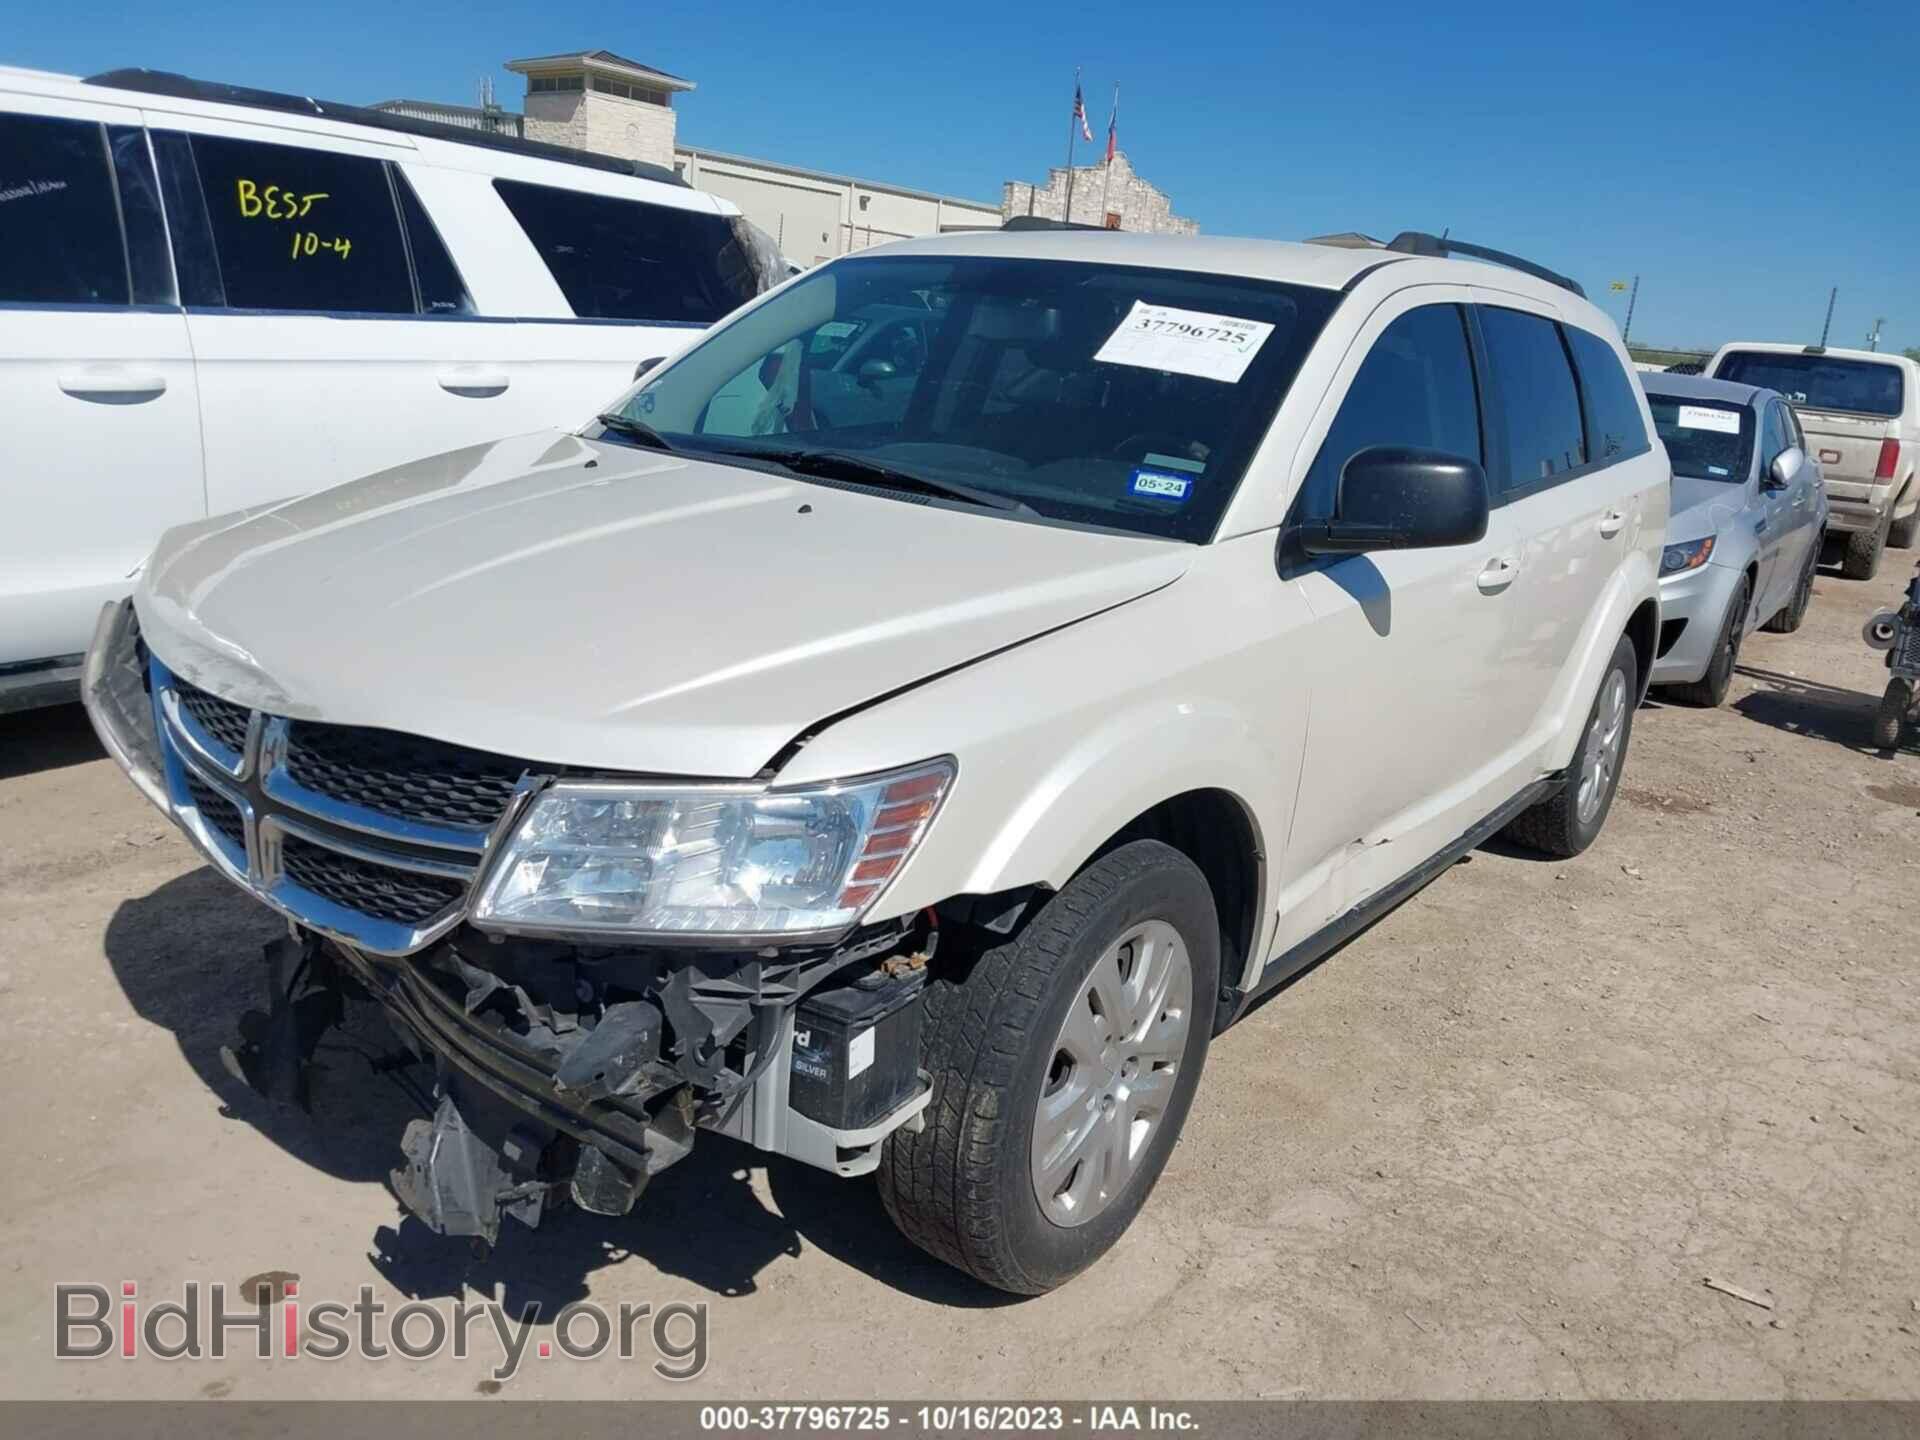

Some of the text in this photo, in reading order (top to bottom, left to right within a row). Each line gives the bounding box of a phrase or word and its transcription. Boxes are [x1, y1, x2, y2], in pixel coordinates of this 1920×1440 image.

[237, 179, 330, 219] BEST
[292, 232, 351, 260] 10-4
[1135, 319, 1248, 343] 37796725
[795, 1060, 827, 1078] SILVER
